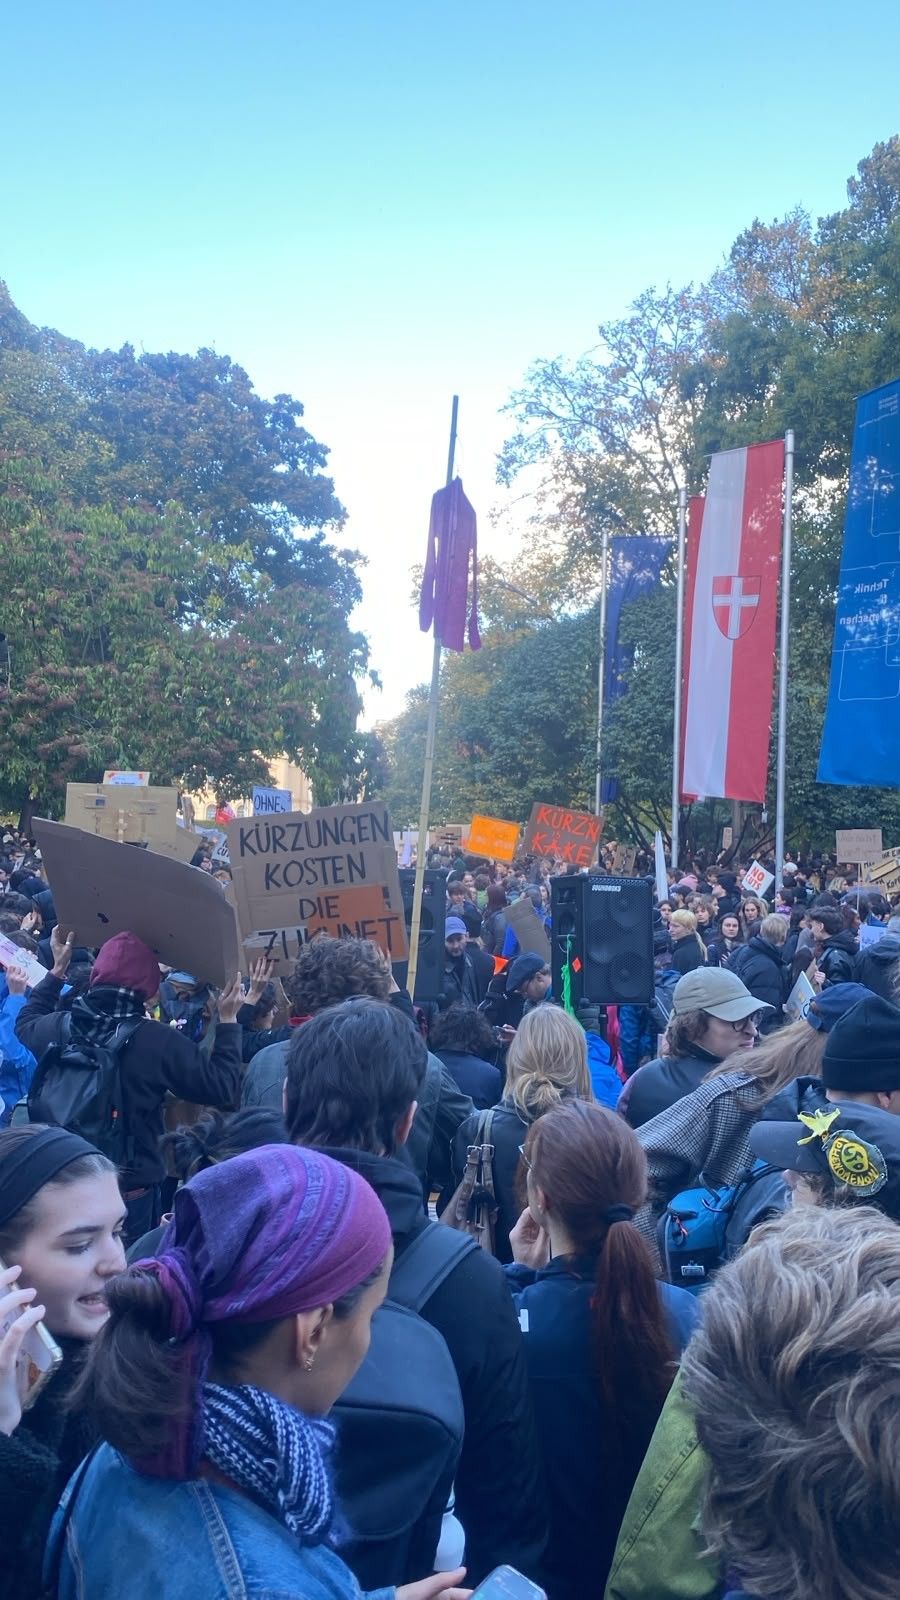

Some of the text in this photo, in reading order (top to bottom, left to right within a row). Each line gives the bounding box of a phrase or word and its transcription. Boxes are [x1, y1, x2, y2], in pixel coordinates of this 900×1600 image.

[239, 811, 392, 857] KÜRZUNGEN
[265, 852, 366, 890] KOSTEN
[745, 874, 762, 891] CUTS
[751, 867, 766, 882] NO
[299, 895, 341, 920] DIE
[831, 1139, 879, 1185] PHENOMENON
